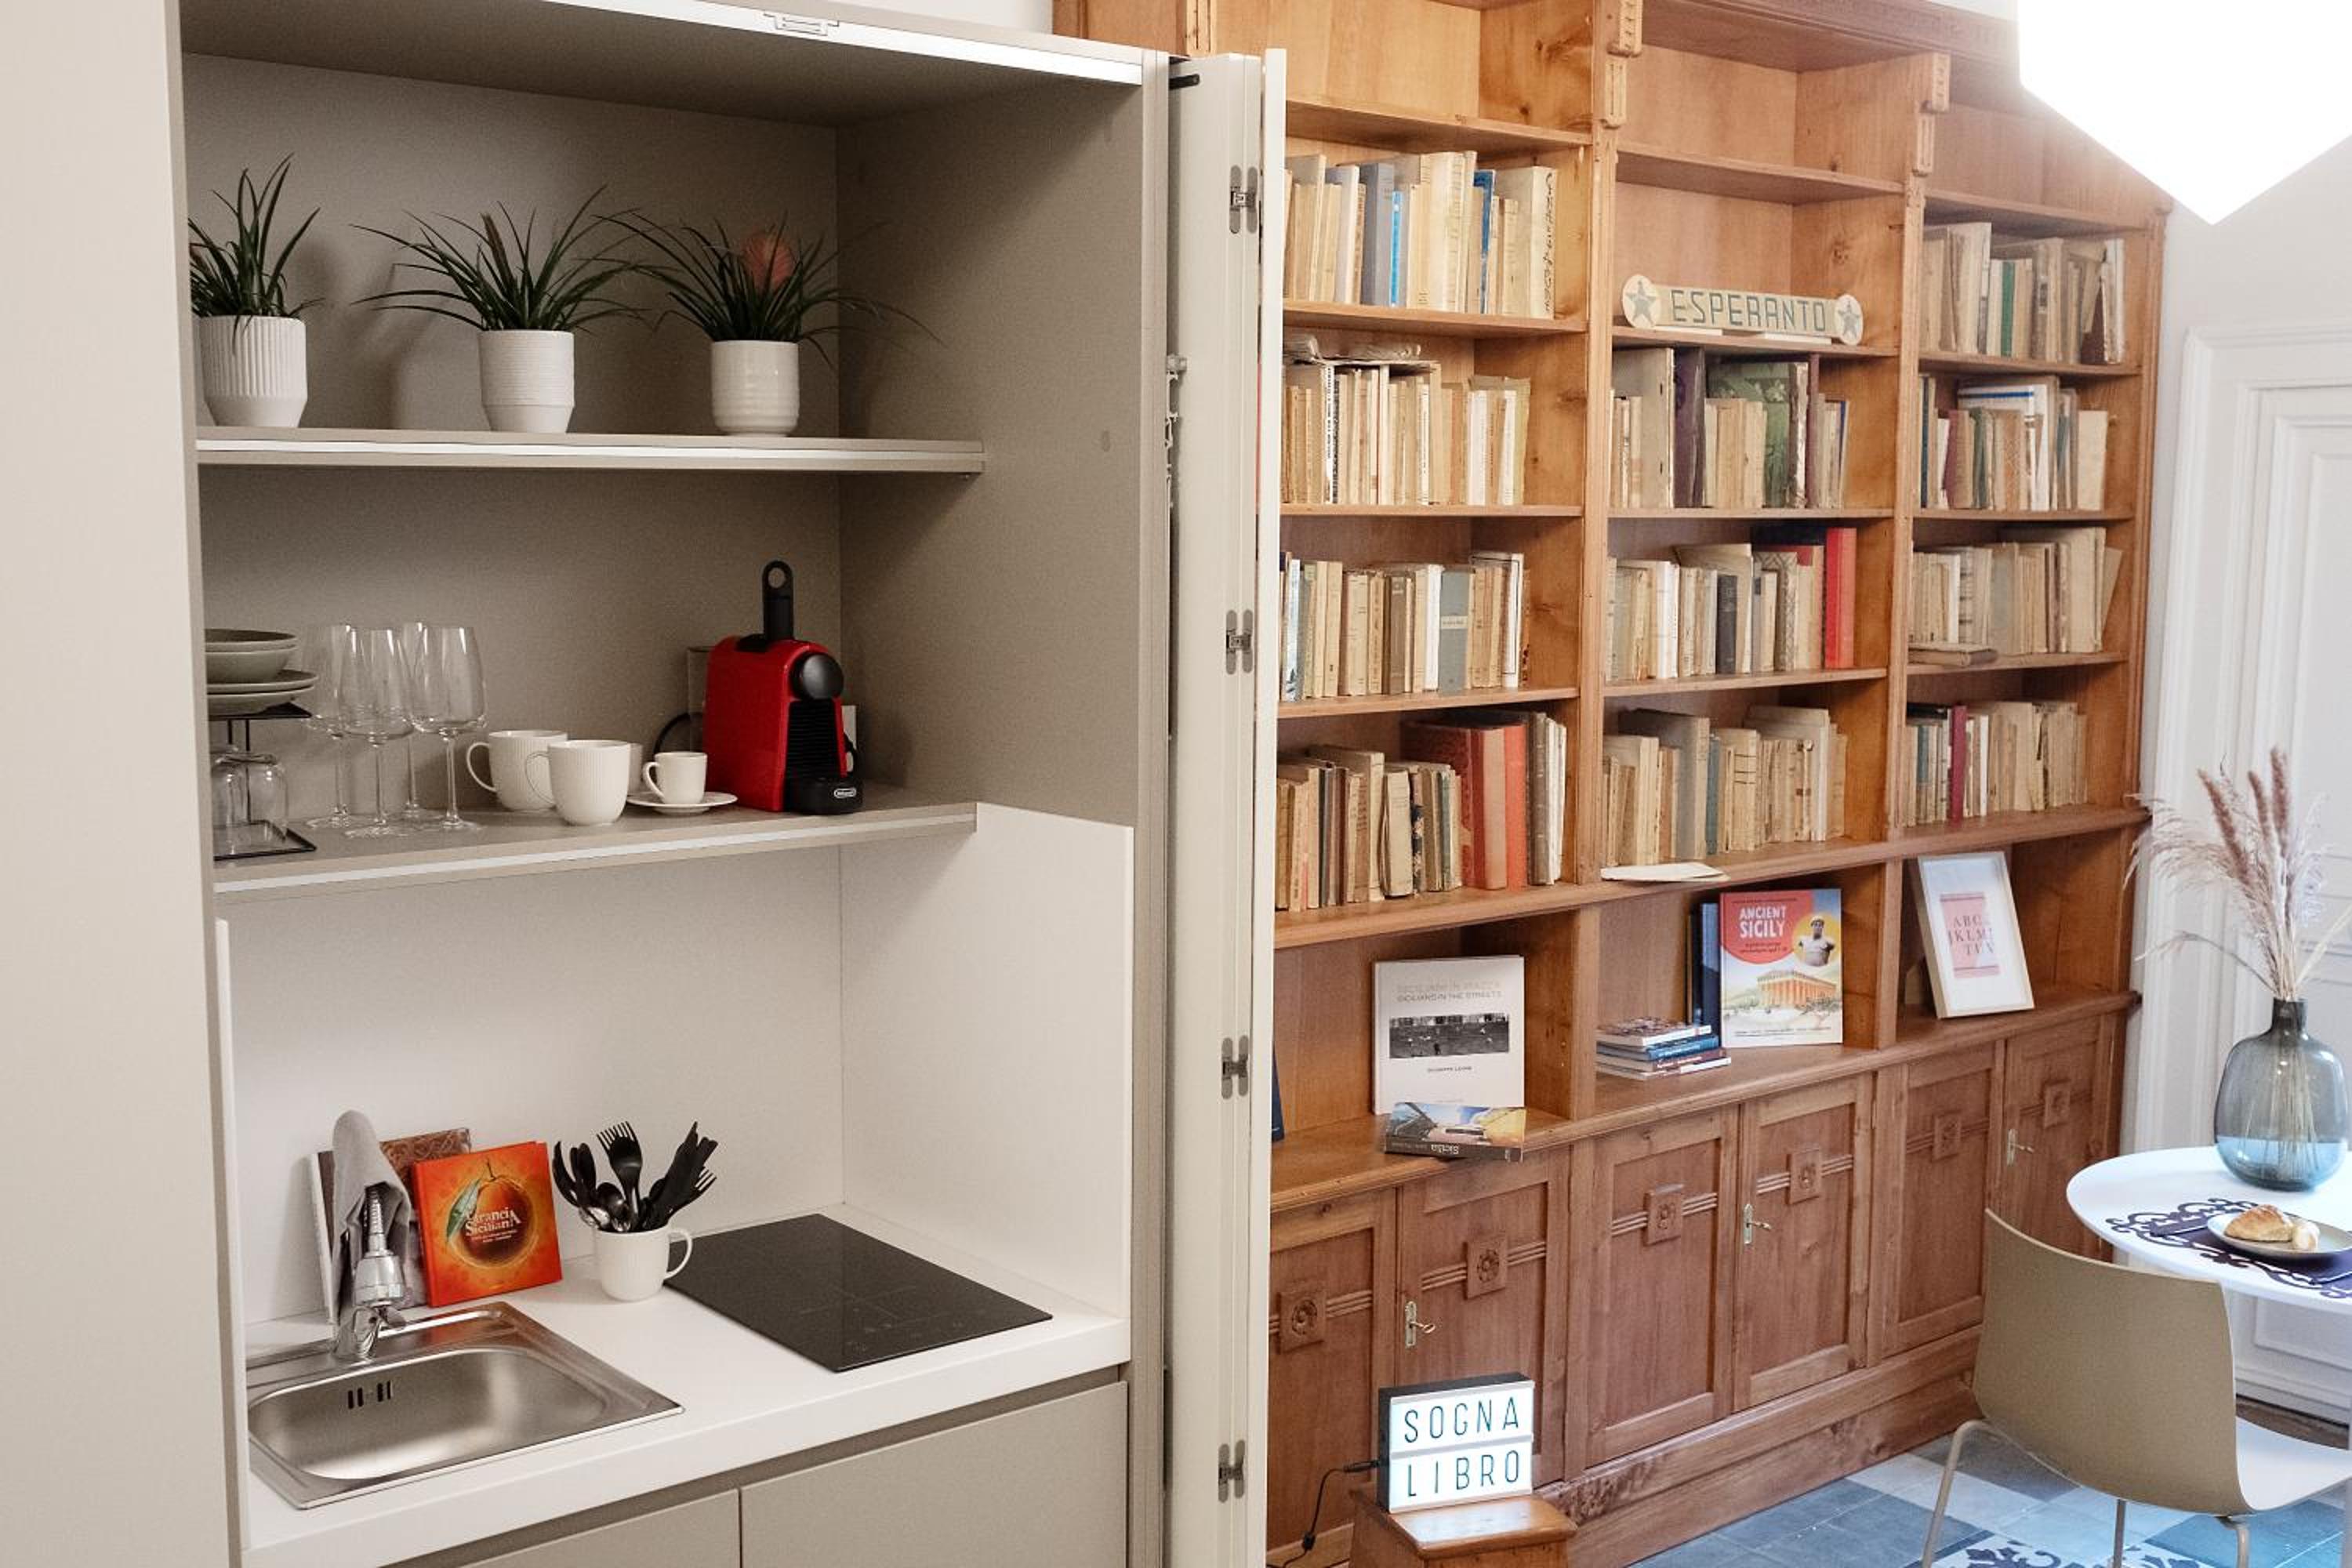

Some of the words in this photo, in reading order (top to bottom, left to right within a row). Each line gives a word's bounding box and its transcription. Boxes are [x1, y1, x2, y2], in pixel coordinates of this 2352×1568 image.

[1671, 289, 1826, 332] ESPERANTO
[1739, 905, 1788, 920] ANCIENT
[1739, 920, 1785, 938] SICILY
[1404, 1396, 1519, 1443] SOGNA
[1406, 1450, 1519, 1497] LIBRO
